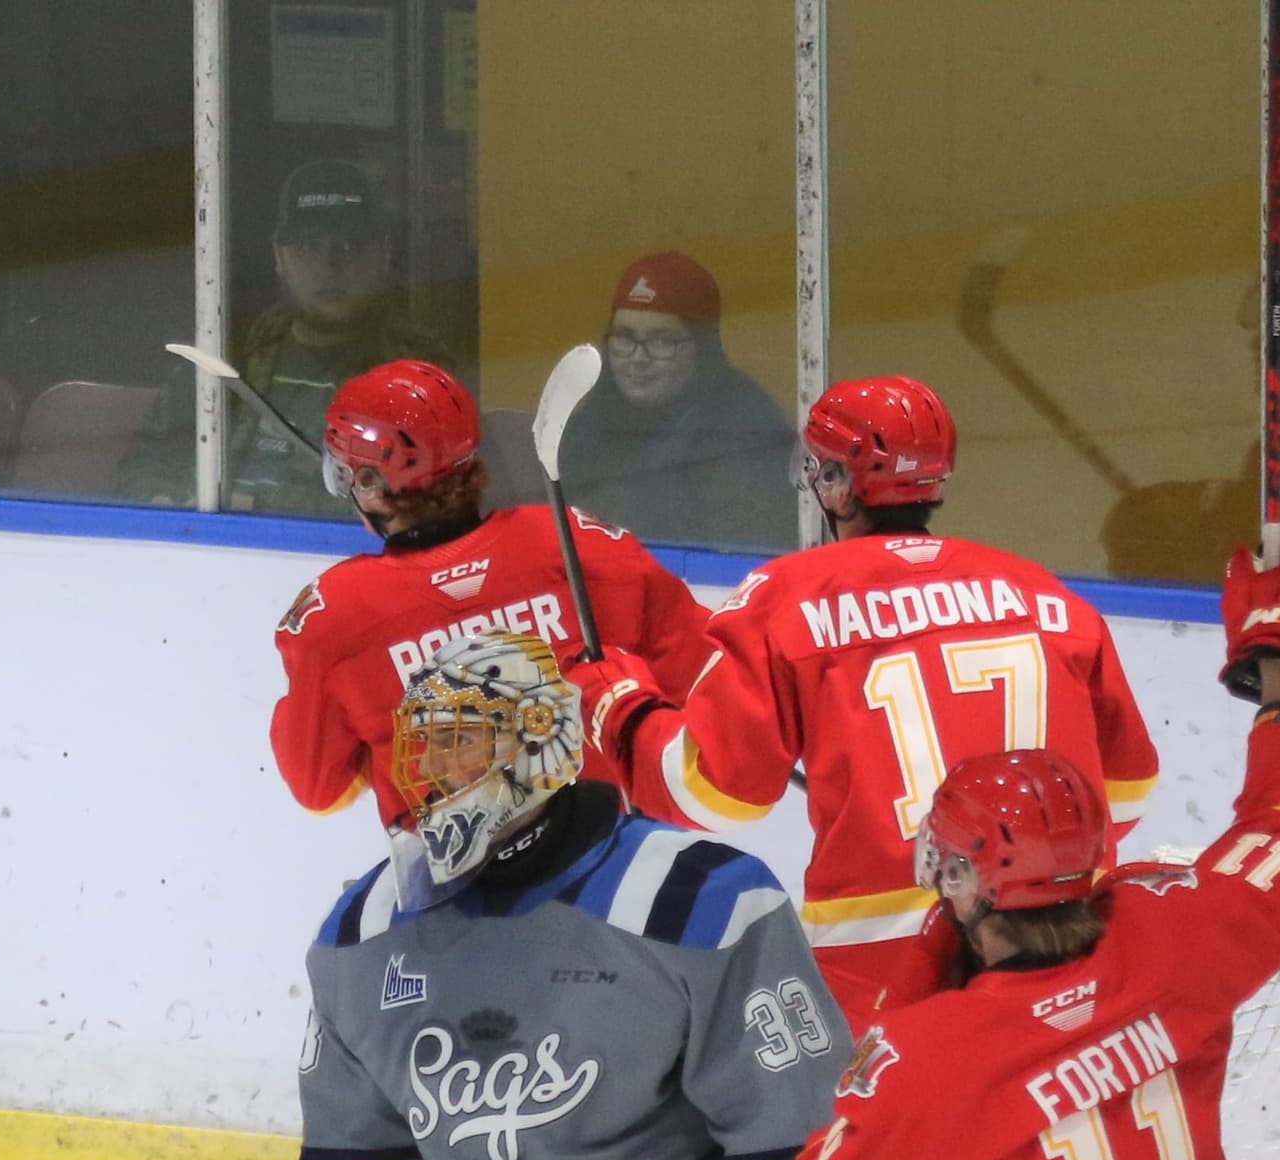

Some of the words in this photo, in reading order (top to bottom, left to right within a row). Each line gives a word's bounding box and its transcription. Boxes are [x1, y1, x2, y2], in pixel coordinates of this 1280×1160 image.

[885, 536, 943, 550] CCM
[430, 558, 490, 585] CCM
[799, 578, 1070, 649] MACDONAD
[863, 632, 1049, 842] 17
[550, 967, 619, 985] CCM
[1031, 979, 1097, 1018] CCM
[744, 977, 832, 1073] 33
[1025, 1012, 1179, 1127] FORTIN
